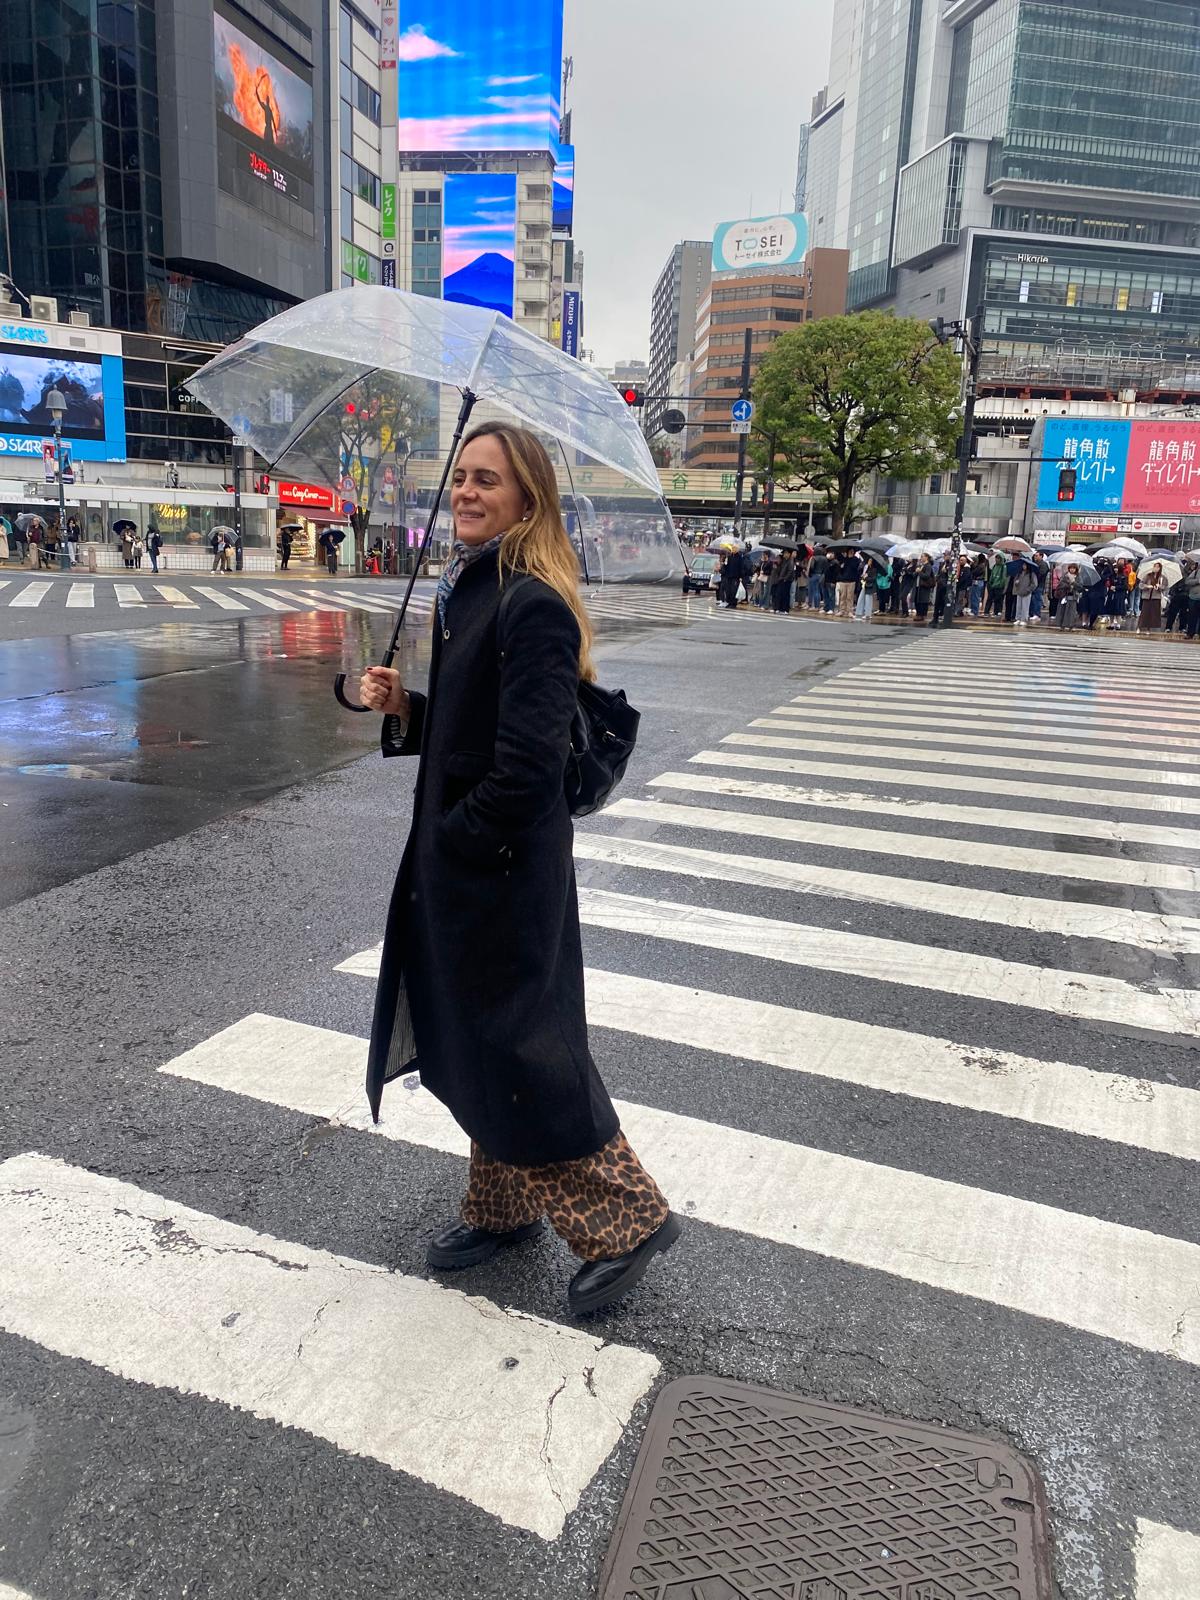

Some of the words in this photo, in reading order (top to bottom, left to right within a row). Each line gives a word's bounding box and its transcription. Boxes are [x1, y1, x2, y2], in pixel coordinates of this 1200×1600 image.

[384, 189, 393, 217] レイク
[735, 234, 783, 251] TOSEI
[1017, 253, 1049, 264] Hikarie
[567, 296, 575, 326] MIZUHO
[1063, 437, 1111, 459] 龍角散
[1149, 439, 1196, 461] 龍角散
[1141, 462, 1200, 485] ダイレクト
